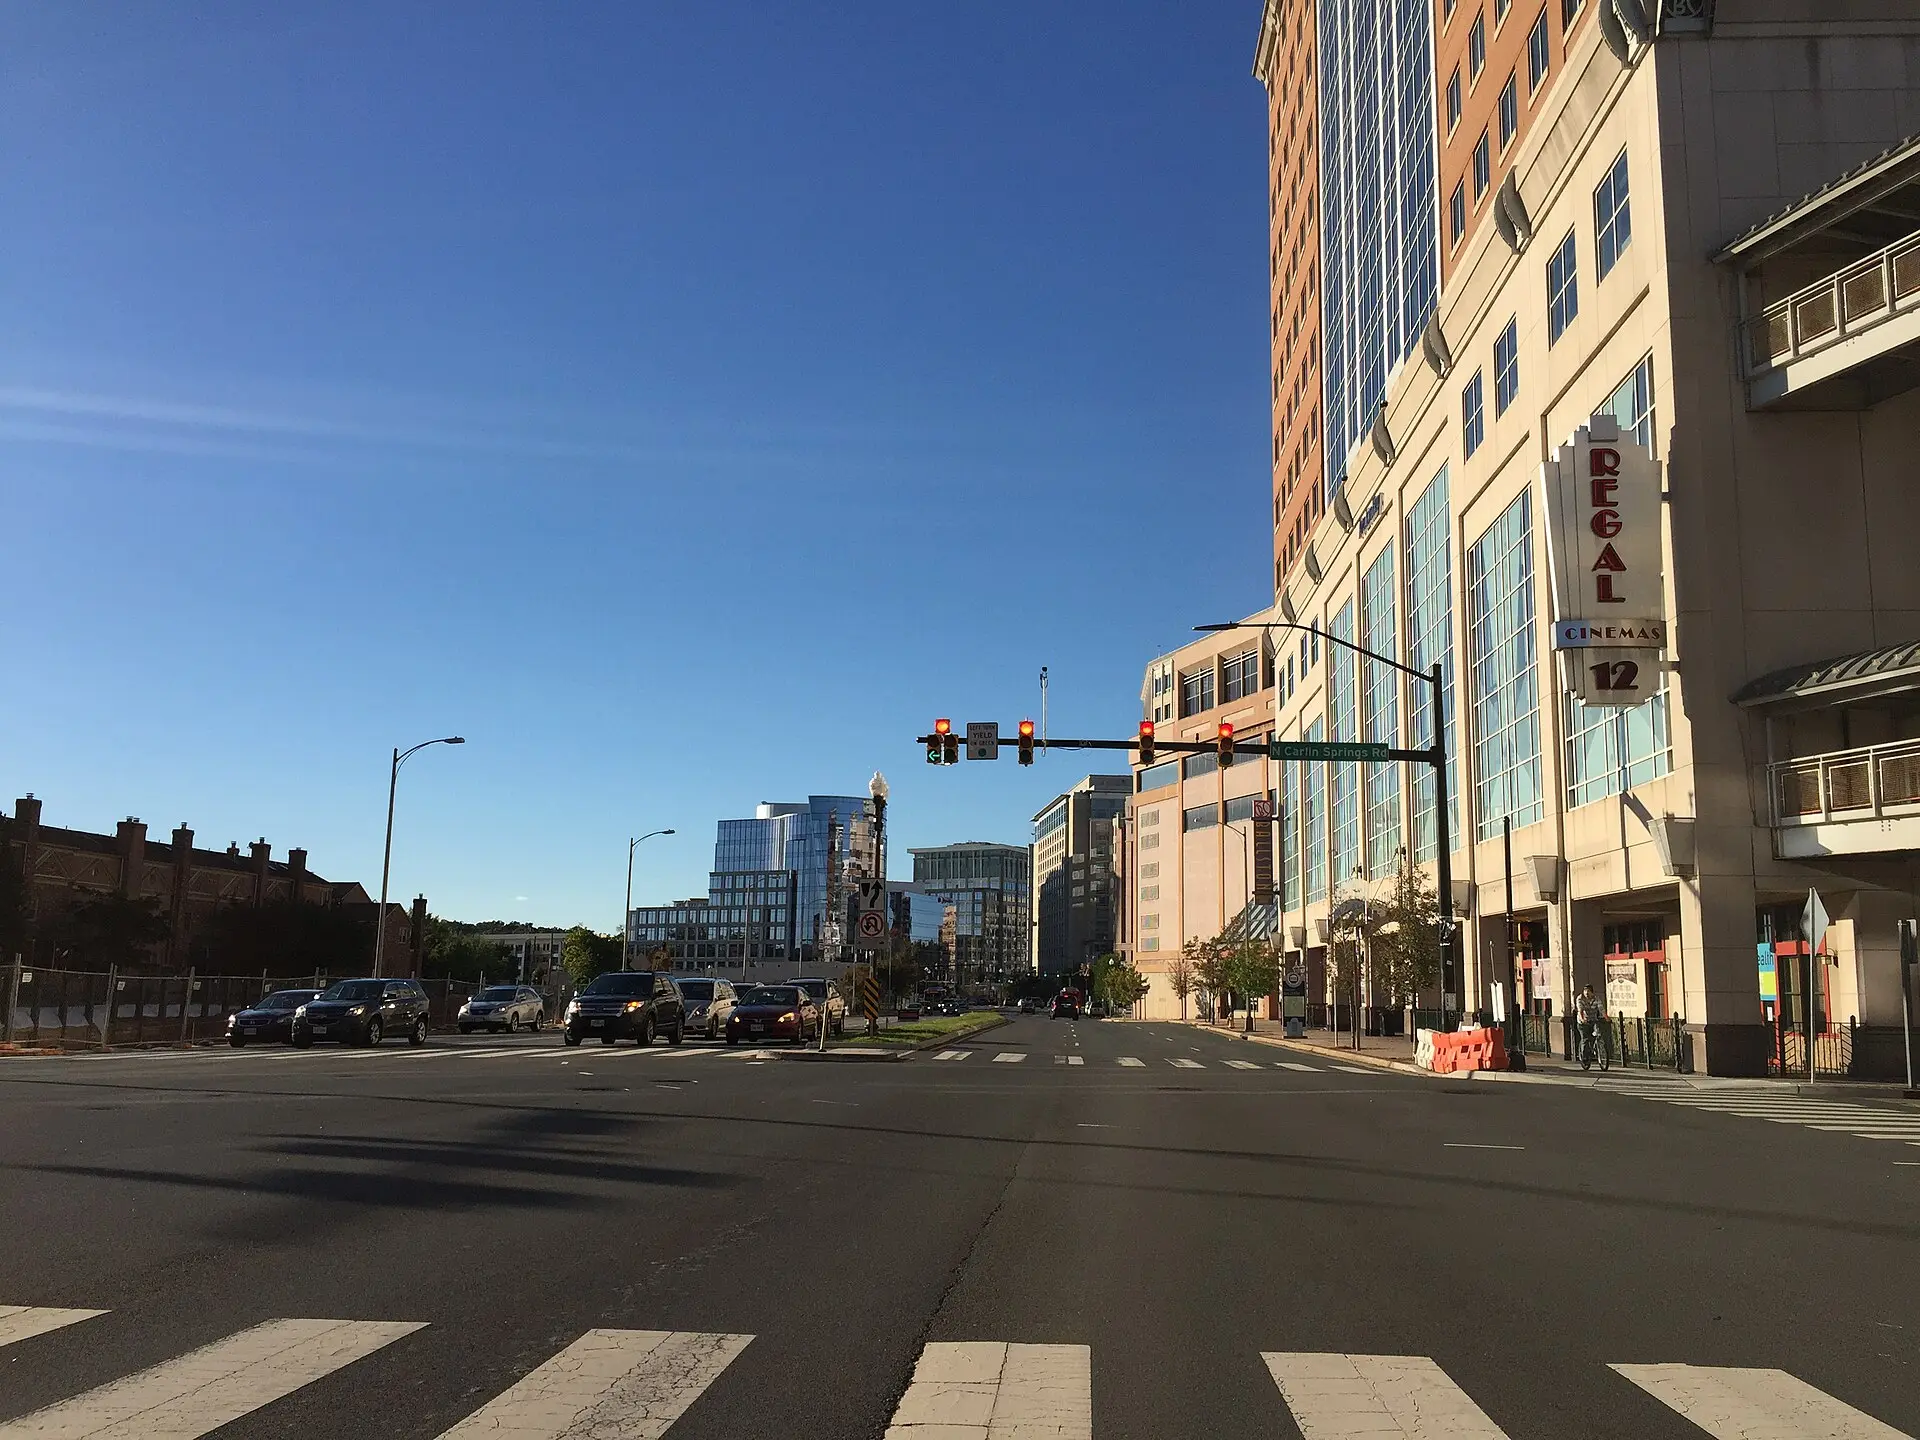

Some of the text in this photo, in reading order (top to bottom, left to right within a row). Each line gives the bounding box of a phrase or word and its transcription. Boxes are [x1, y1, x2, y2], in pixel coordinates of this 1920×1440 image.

[1590, 448, 1627, 603] REGAL
[1564, 626, 1660, 640] CINEMAS
[1589, 660, 1639, 691] 12
[1272, 746, 1386, 759] N Carlin Springs Rd
